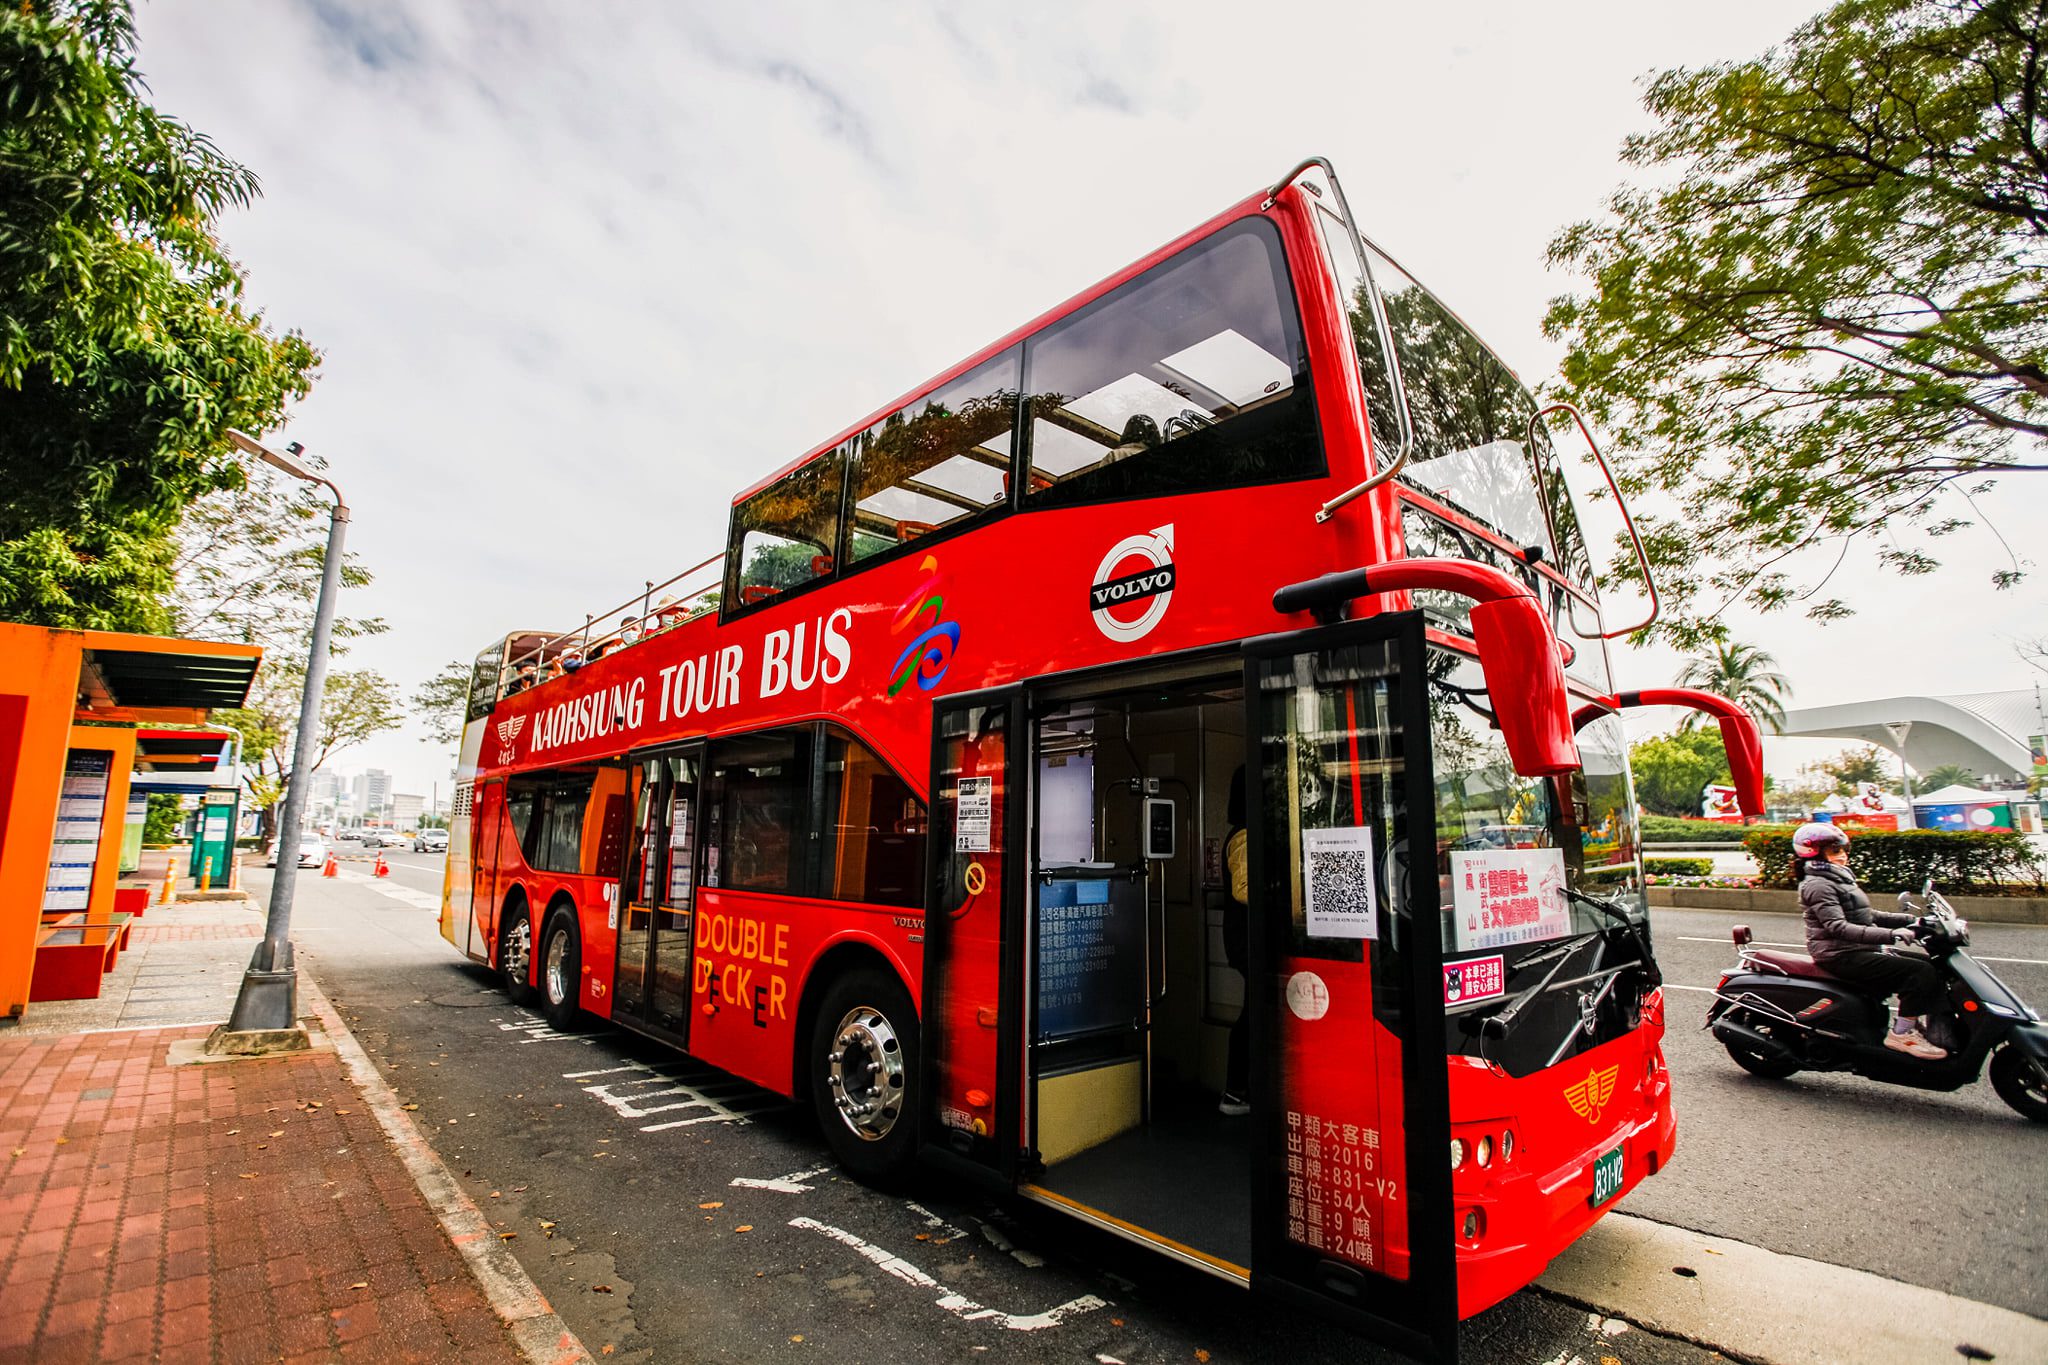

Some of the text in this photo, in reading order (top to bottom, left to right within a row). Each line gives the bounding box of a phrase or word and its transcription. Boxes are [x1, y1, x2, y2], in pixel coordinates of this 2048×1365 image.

[1092, 571, 1172, 604] VOLVO
[530, 607, 852, 753] KAOHSIUNG TOUR BUS
[1487, 867, 1529, 899] 雙層巴士
[696, 911, 790, 967] DOUBLE
[1465, 961, 1499, 980] 本車已消毒
[1465, 976, 1500, 995] 請安心搭乘
[694, 956, 787, 1028] DECKER
[1287, 1111, 1380, 1150] 甲類大客車
[1287, 1132, 1374, 1171] 出廠:2016
[1287, 1154, 1397, 1200] 車牌:831-V2
[1288, 1176, 1372, 1218] 座位:54人
[1289, 1220, 1374, 1266] 總重:24噸
